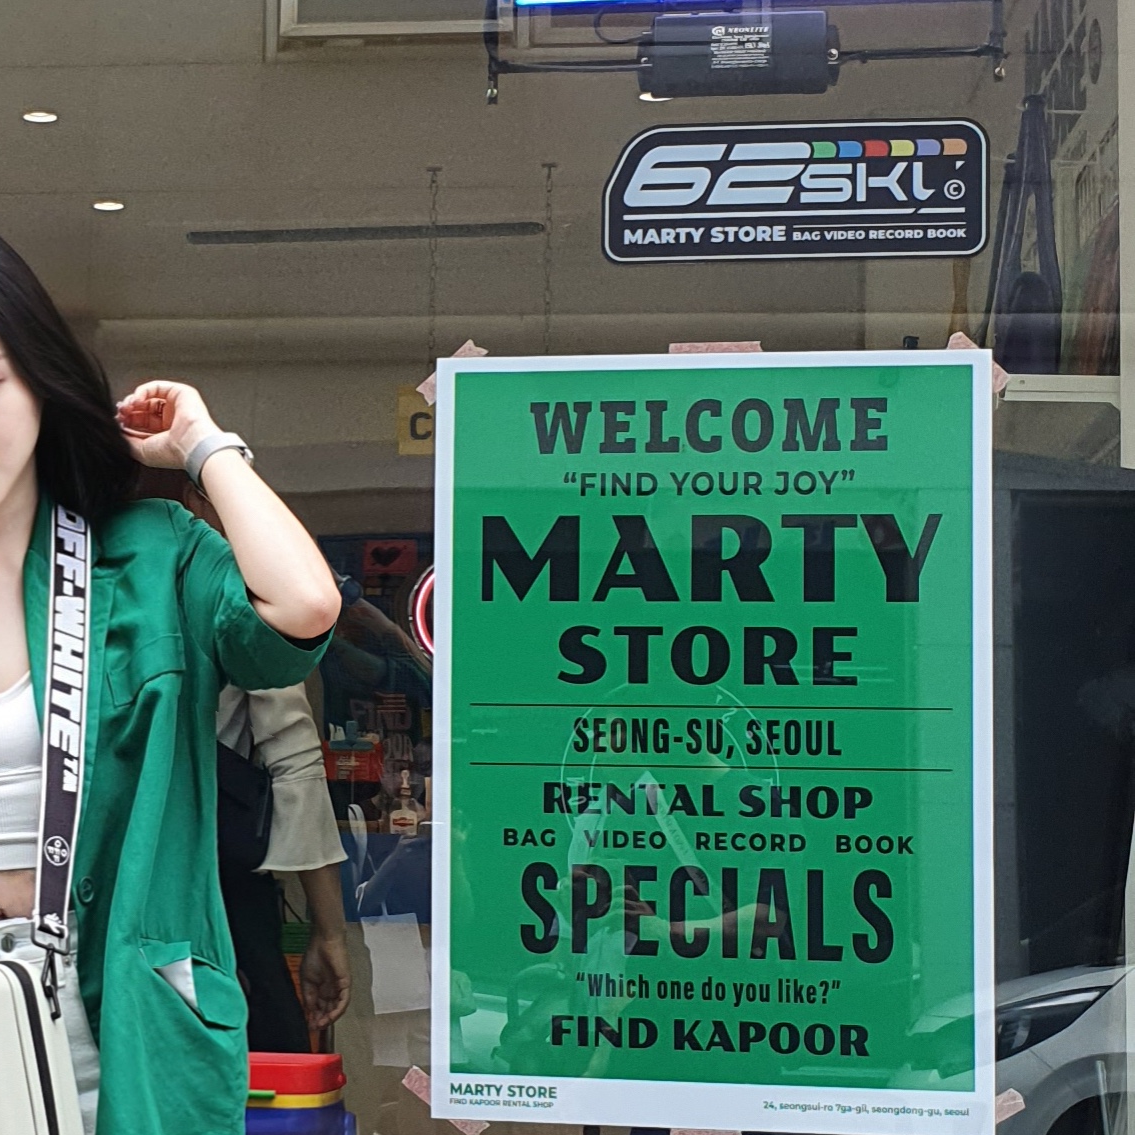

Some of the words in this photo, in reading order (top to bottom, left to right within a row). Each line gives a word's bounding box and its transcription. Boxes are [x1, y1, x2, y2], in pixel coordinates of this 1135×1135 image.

[623, 227, 705, 245] MARTY
[710, 225, 786, 243] STORE
[792, 230, 820, 242] BAG
[823, 229, 866, 241] VIDEO
[868, 229, 924, 241] RECORD
[927, 228, 967, 239] BOOK
[530, 397, 889, 455] WELCOME
[670, 471, 763, 496] YOUR
[481, 513, 943, 603] MARTY
[557, 625, 859, 687] STORE
[573, 718, 734, 759] SEONG-SU,
[747, 719, 842, 756] SEOUL
[542, 781, 725, 817] RENTAL
[738, 784, 874, 819] SHOP
[503, 828, 556, 848] BAG
[584, 829, 668, 850] VIDEO
[695, 832, 807, 853] RECORD
[836, 834, 914, 855] BOOK
[520, 861, 895, 964] SPECIALS
[656, 980, 695, 1000] one
[702, 975, 726, 1002] do
[732, 983, 770, 1008] you
[550, 1013, 658, 1049] FIND
[673, 1018, 870, 1057] KAPOOR
[450, 1082, 503, 1096] MARTY
[507, 1084, 558, 1099] STORE
[469, 1098, 501, 1106] KAPOOR
[503, 1099, 531, 1107] RENTAL
[763, 1101, 777, 1110] 24,
[871, 1105, 942, 1117] seongdong-gu,
[944, 1107, 969, 1116] seoul
